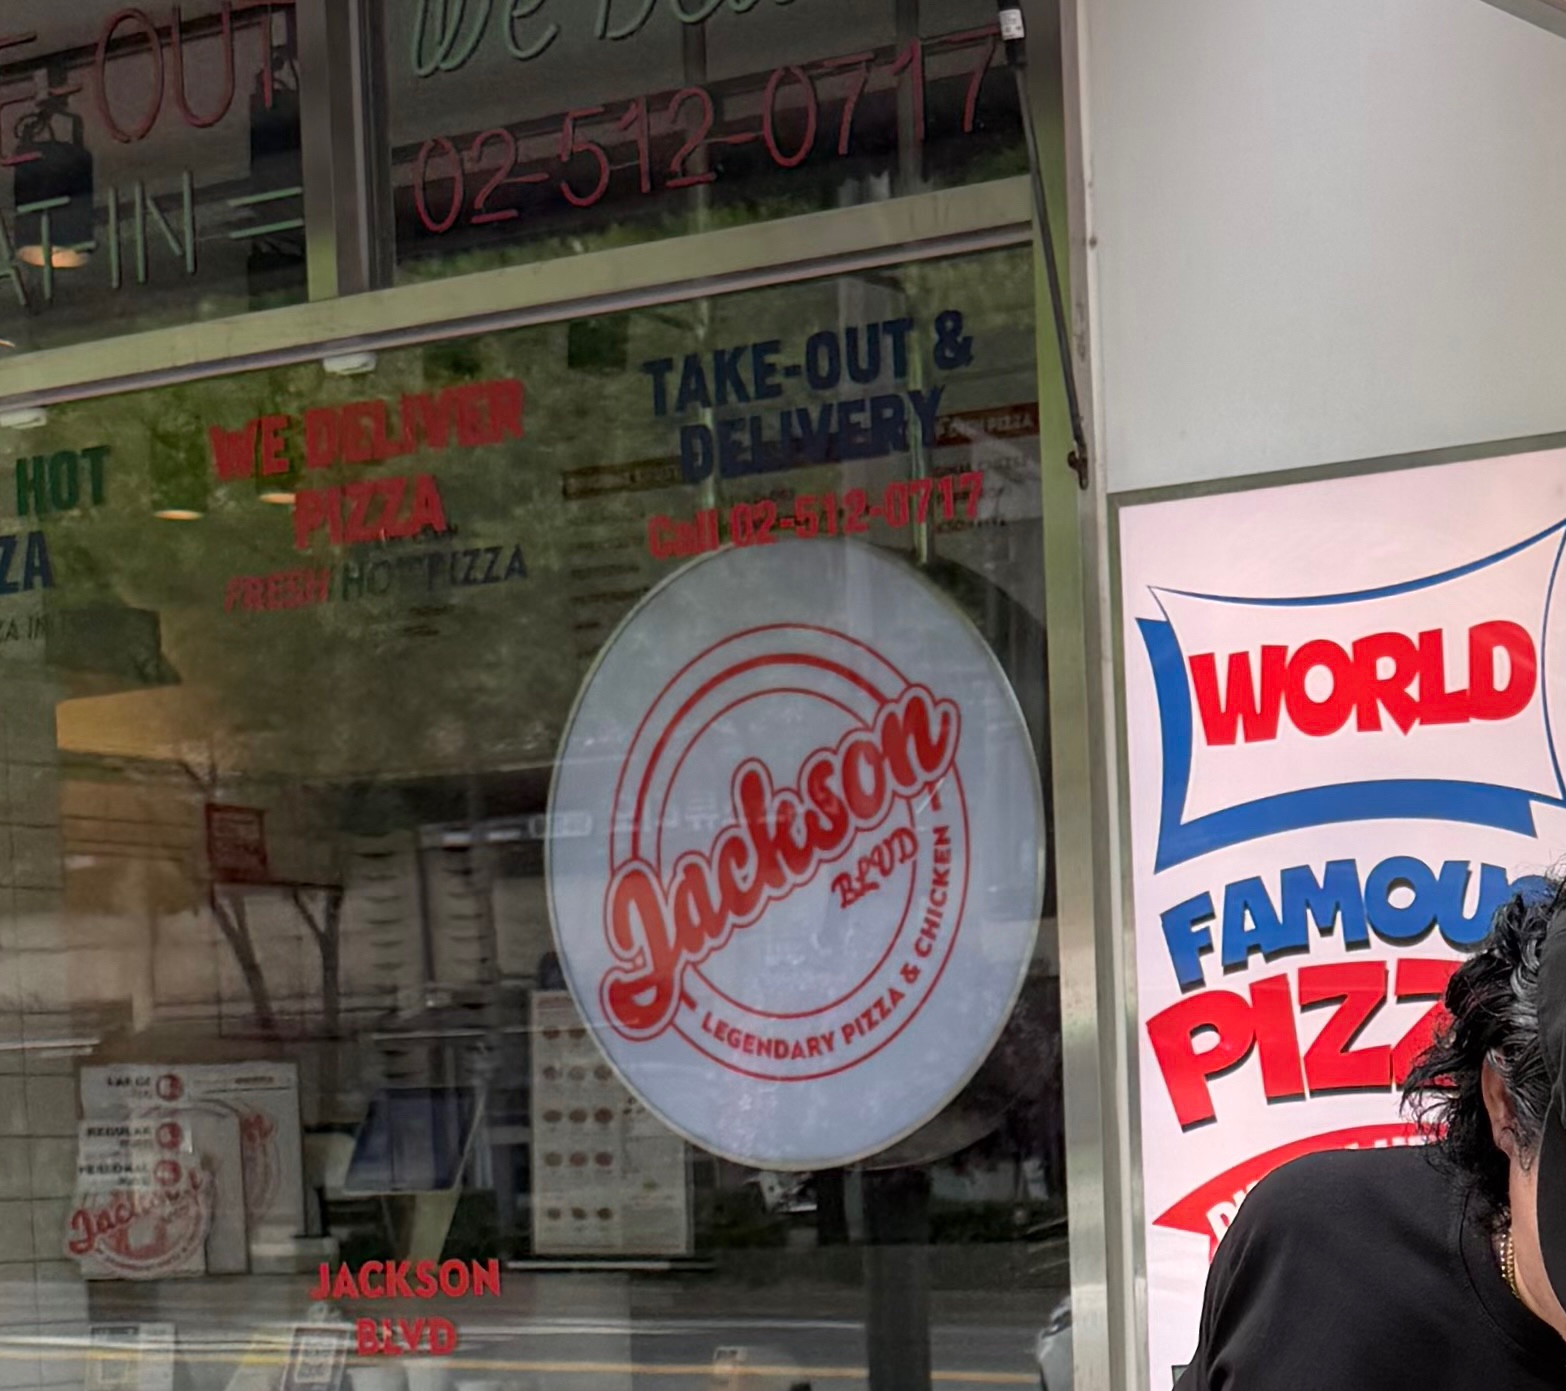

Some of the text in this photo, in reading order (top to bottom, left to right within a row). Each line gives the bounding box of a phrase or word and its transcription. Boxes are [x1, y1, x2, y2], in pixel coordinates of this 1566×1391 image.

[641, 310, 974, 417] TAKE-OUT &
[209, 378, 524, 481] WE DELIVER
[680, 385, 945, 485] DELIVERY
[16, 445, 112, 521] HOT
[293, 474, 446, 549] PIZZA
[648, 504, 719, 560] Call
[730, 473, 983, 548] 02-512-0717
[224, 567, 332, 614] FRESH
[427, 544, 528, 592] PIZZA
[1189, 620, 1537, 748] WORLD
[604, 690, 957, 1036] Jackson
[831, 825, 919, 909] BLVD
[702, 825, 952, 1062] LEGENDARY PIZZA & CHICKEN
[1160, 853, 1552, 997] FAMOU
[311, 1258, 500, 1301] JACKSON
[356, 1317, 458, 1357] BLVD
